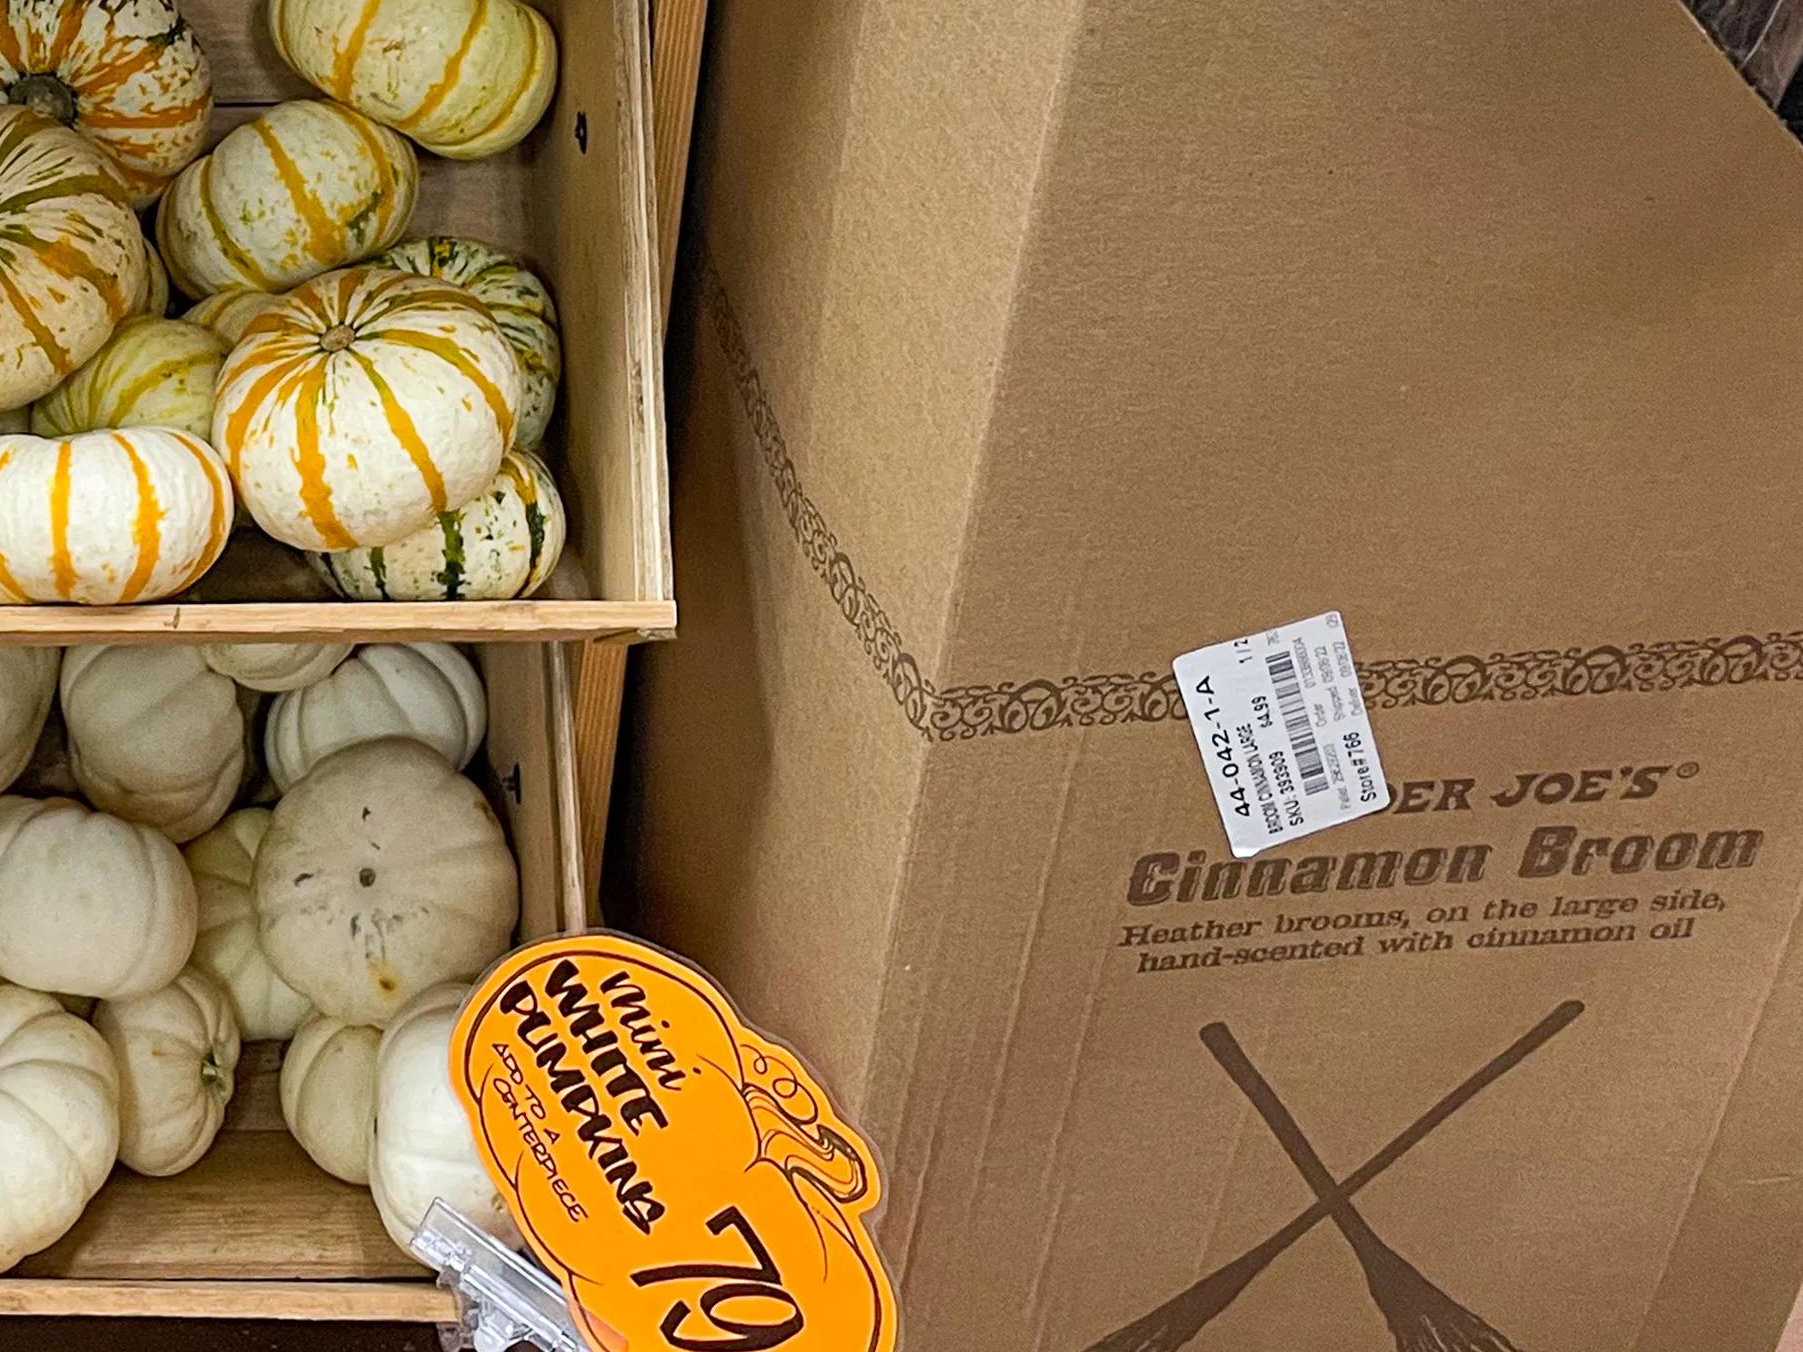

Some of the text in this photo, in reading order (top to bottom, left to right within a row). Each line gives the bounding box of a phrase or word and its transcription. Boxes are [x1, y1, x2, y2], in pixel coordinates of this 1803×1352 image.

[1196, 675, 1250, 817] 44-042-1-A
[1236, 723, 1259, 756] LARGE
[1251, 695, 1273, 728] $4.99
[1259, 800, 1284, 834] BROOM
[1283, 795, 1304, 826] SKU:
[1379, 778, 1475, 814] ER
[1126, 825, 1765, 907] Cinnamon Broom
[1117, 889, 1726, 948] Heather brooms, on the large side,
[1136, 917, 1696, 974] hand-scented with cinnamon oil
[545, 959, 670, 1137] WHITE
[492, 1042, 561, 1146] ADD TO A
[499, 981, 665, 1235] PUMPKINS
[493, 1077, 588, 1223] CENTERPIECE
[629, 1205, 805, 1352] 79
